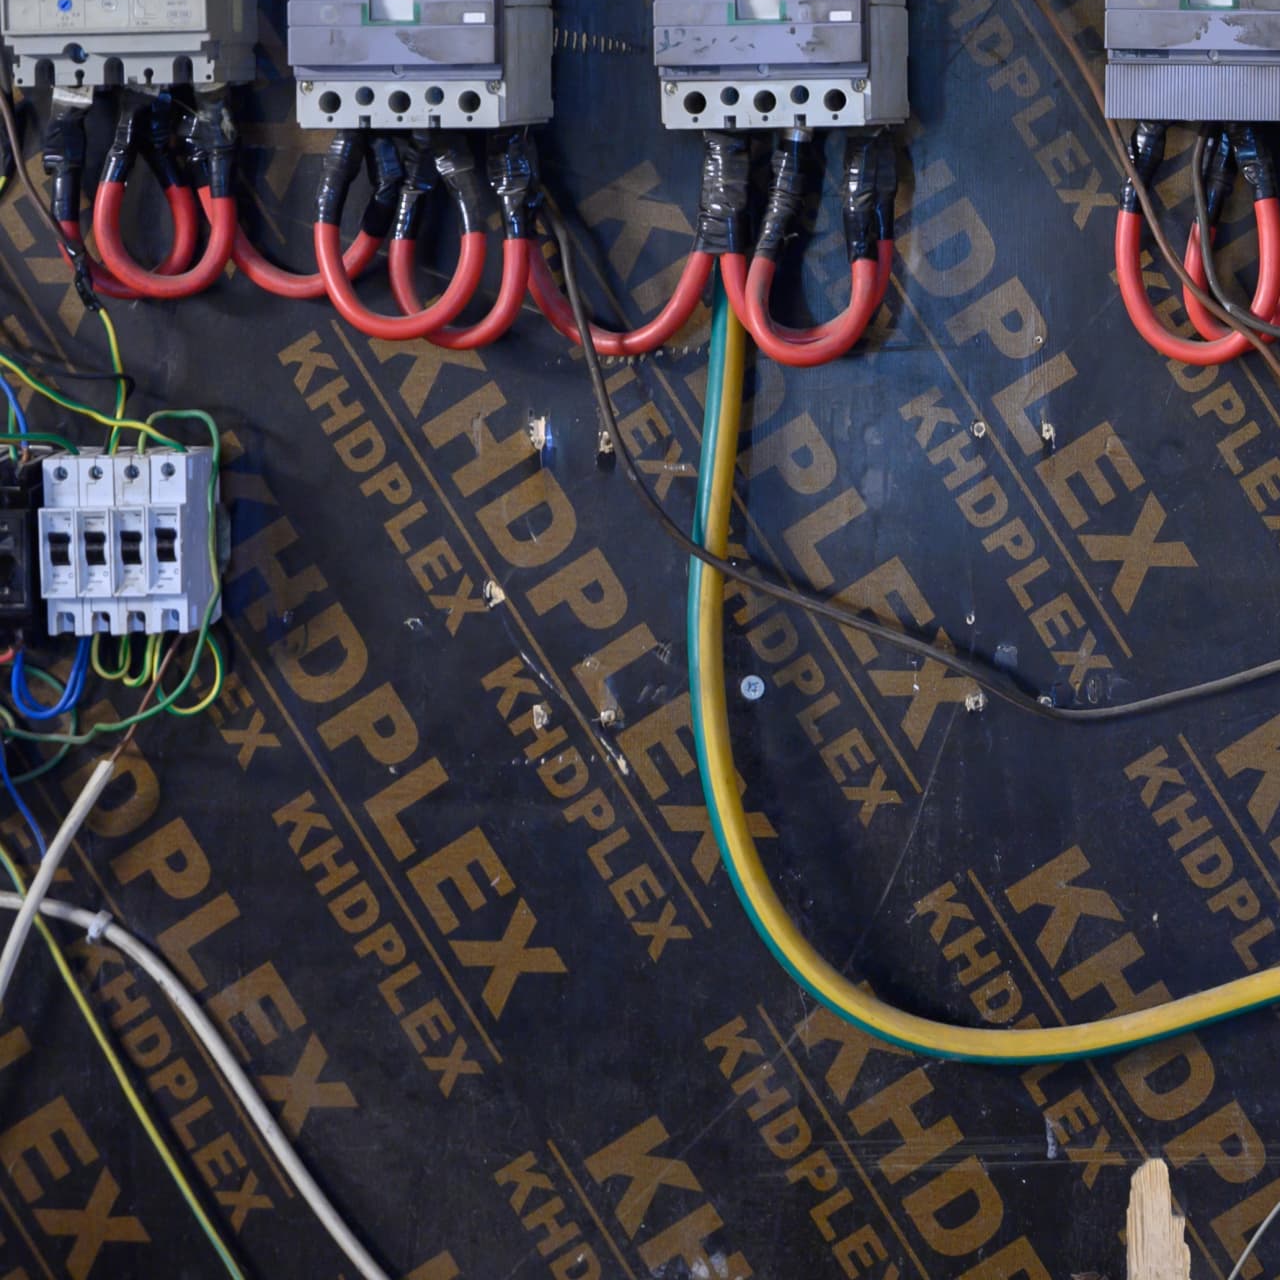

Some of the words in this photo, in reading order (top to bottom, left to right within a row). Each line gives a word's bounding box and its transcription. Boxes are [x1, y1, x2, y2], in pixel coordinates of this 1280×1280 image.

[273, 327, 492, 639] KHDPLEX
[894, 383, 1114, 696] KHDPLEX
[267, 789, 486, 1098] KHDPLEX
[475, 655, 694, 964] KHDPLEX
[698, 1013, 905, 1280] KHDPLE
[909, 879, 1129, 1191] KHDLEX
